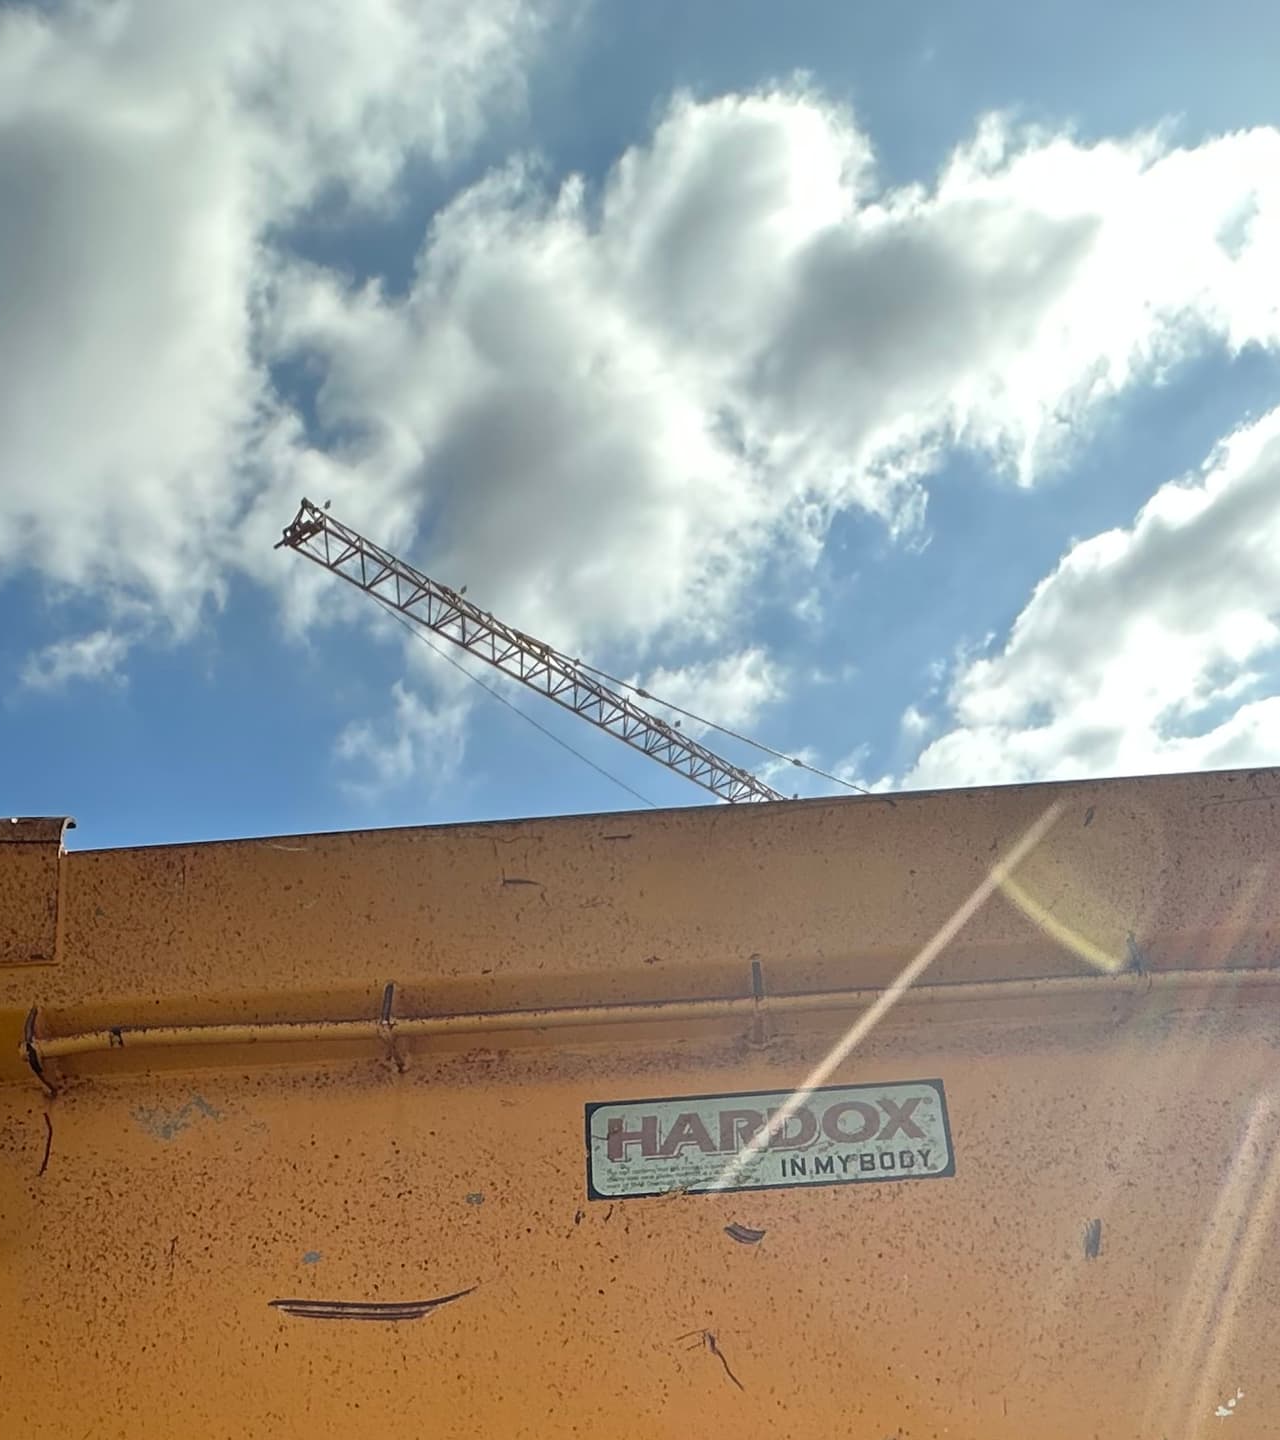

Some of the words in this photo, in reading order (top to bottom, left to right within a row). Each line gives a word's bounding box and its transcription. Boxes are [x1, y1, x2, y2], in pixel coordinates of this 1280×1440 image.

[607, 1098, 926, 1162] HARDOX
[781, 1158, 806, 1177] IN
[815, 1154, 850, 1177] MY
[860, 1150, 931, 1171] BODY
